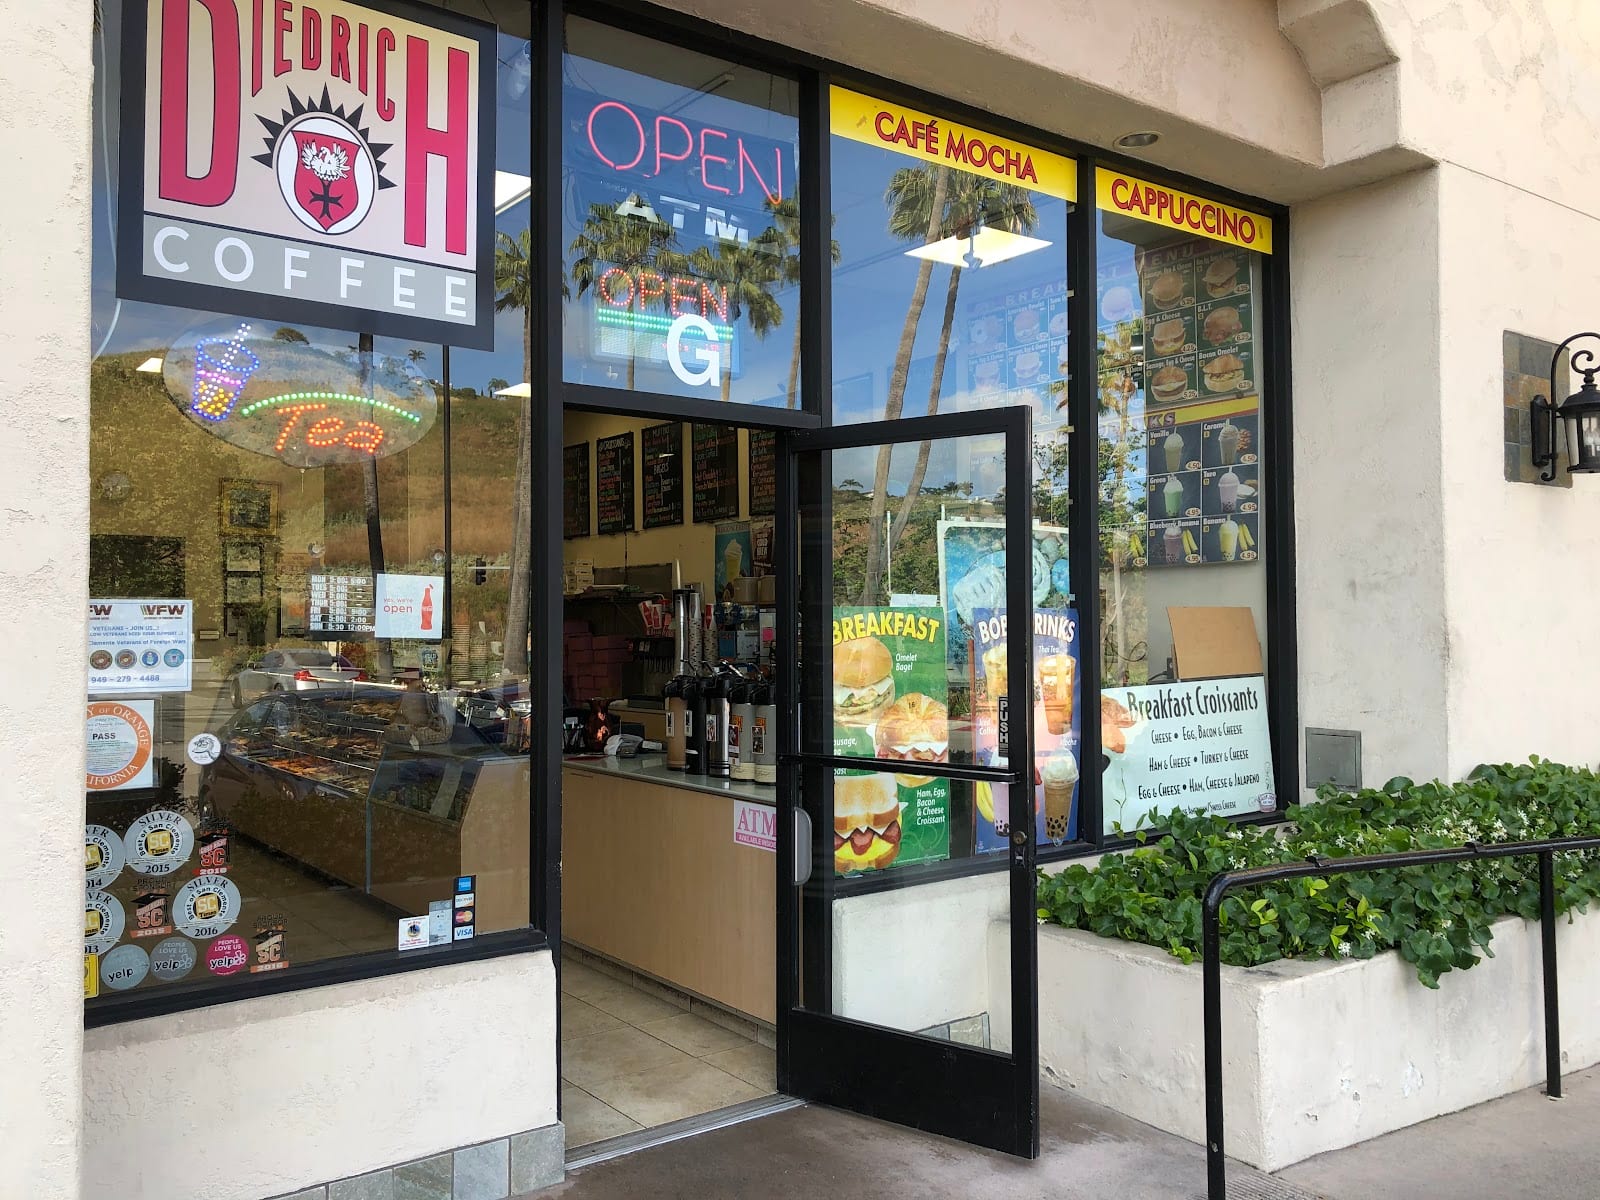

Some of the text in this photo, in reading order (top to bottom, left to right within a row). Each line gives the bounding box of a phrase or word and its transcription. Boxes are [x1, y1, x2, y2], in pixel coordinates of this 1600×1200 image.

[158, 0, 469, 256] DIEDRICH
[587, 101, 782, 205] OPEN
[874, 111, 1038, 184] CAFÉ MOCHA
[1111, 178, 1256, 243] CAPPUCCINO
[153, 226, 467, 317] COFFEE
[600, 268, 728, 322] OPEN
[666, 313, 720, 387] G
[1217, 346, 1238, 356] Omelet
[274, 403, 384, 453] Tea
[1150, 430, 1169, 438] Vanilla
[145, 604, 185, 615] VFW
[384, 603, 413, 614] open
[833, 611, 940, 646] BREAKFAST
[1034, 612, 1076, 643] RINKS
[896, 653, 918, 662] Omelet
[896, 662, 913, 672] Bagel
[1126, 686, 1258, 722] Breakfast Croissants
[113, 706, 149, 745] ORANGE
[1000, 700, 1008, 743] PUSH
[917, 788, 946, 798] Ham, Egg,
[917, 799, 935, 807] Bacon
[923, 807, 944, 815] Cheese
[138, 812, 182, 827] SILVER
[738, 807, 776, 837] ATM
[917, 816, 945, 825] Croissant
[138, 839, 146, 856] Best
[165, 824, 180, 855] Clemente
[150, 832, 169, 847] SC
[93, 838, 110, 868] Clemente
[201, 847, 224, 866] SC
[145, 864, 170, 874] 2015
[187, 877, 228, 892] SILVER
[186, 904, 194, 920] Best
[213, 888, 227, 917] Clemente
[198, 896, 217, 911] SC
[96, 903, 110, 936] Clemente
[138, 907, 163, 929] SC
[195, 927, 218, 936] 2016
[211, 956, 234, 969] yelp
[258, 944, 280, 964] SC
[108, 968, 133, 982] yelp
[155, 960, 180, 971] yelp
